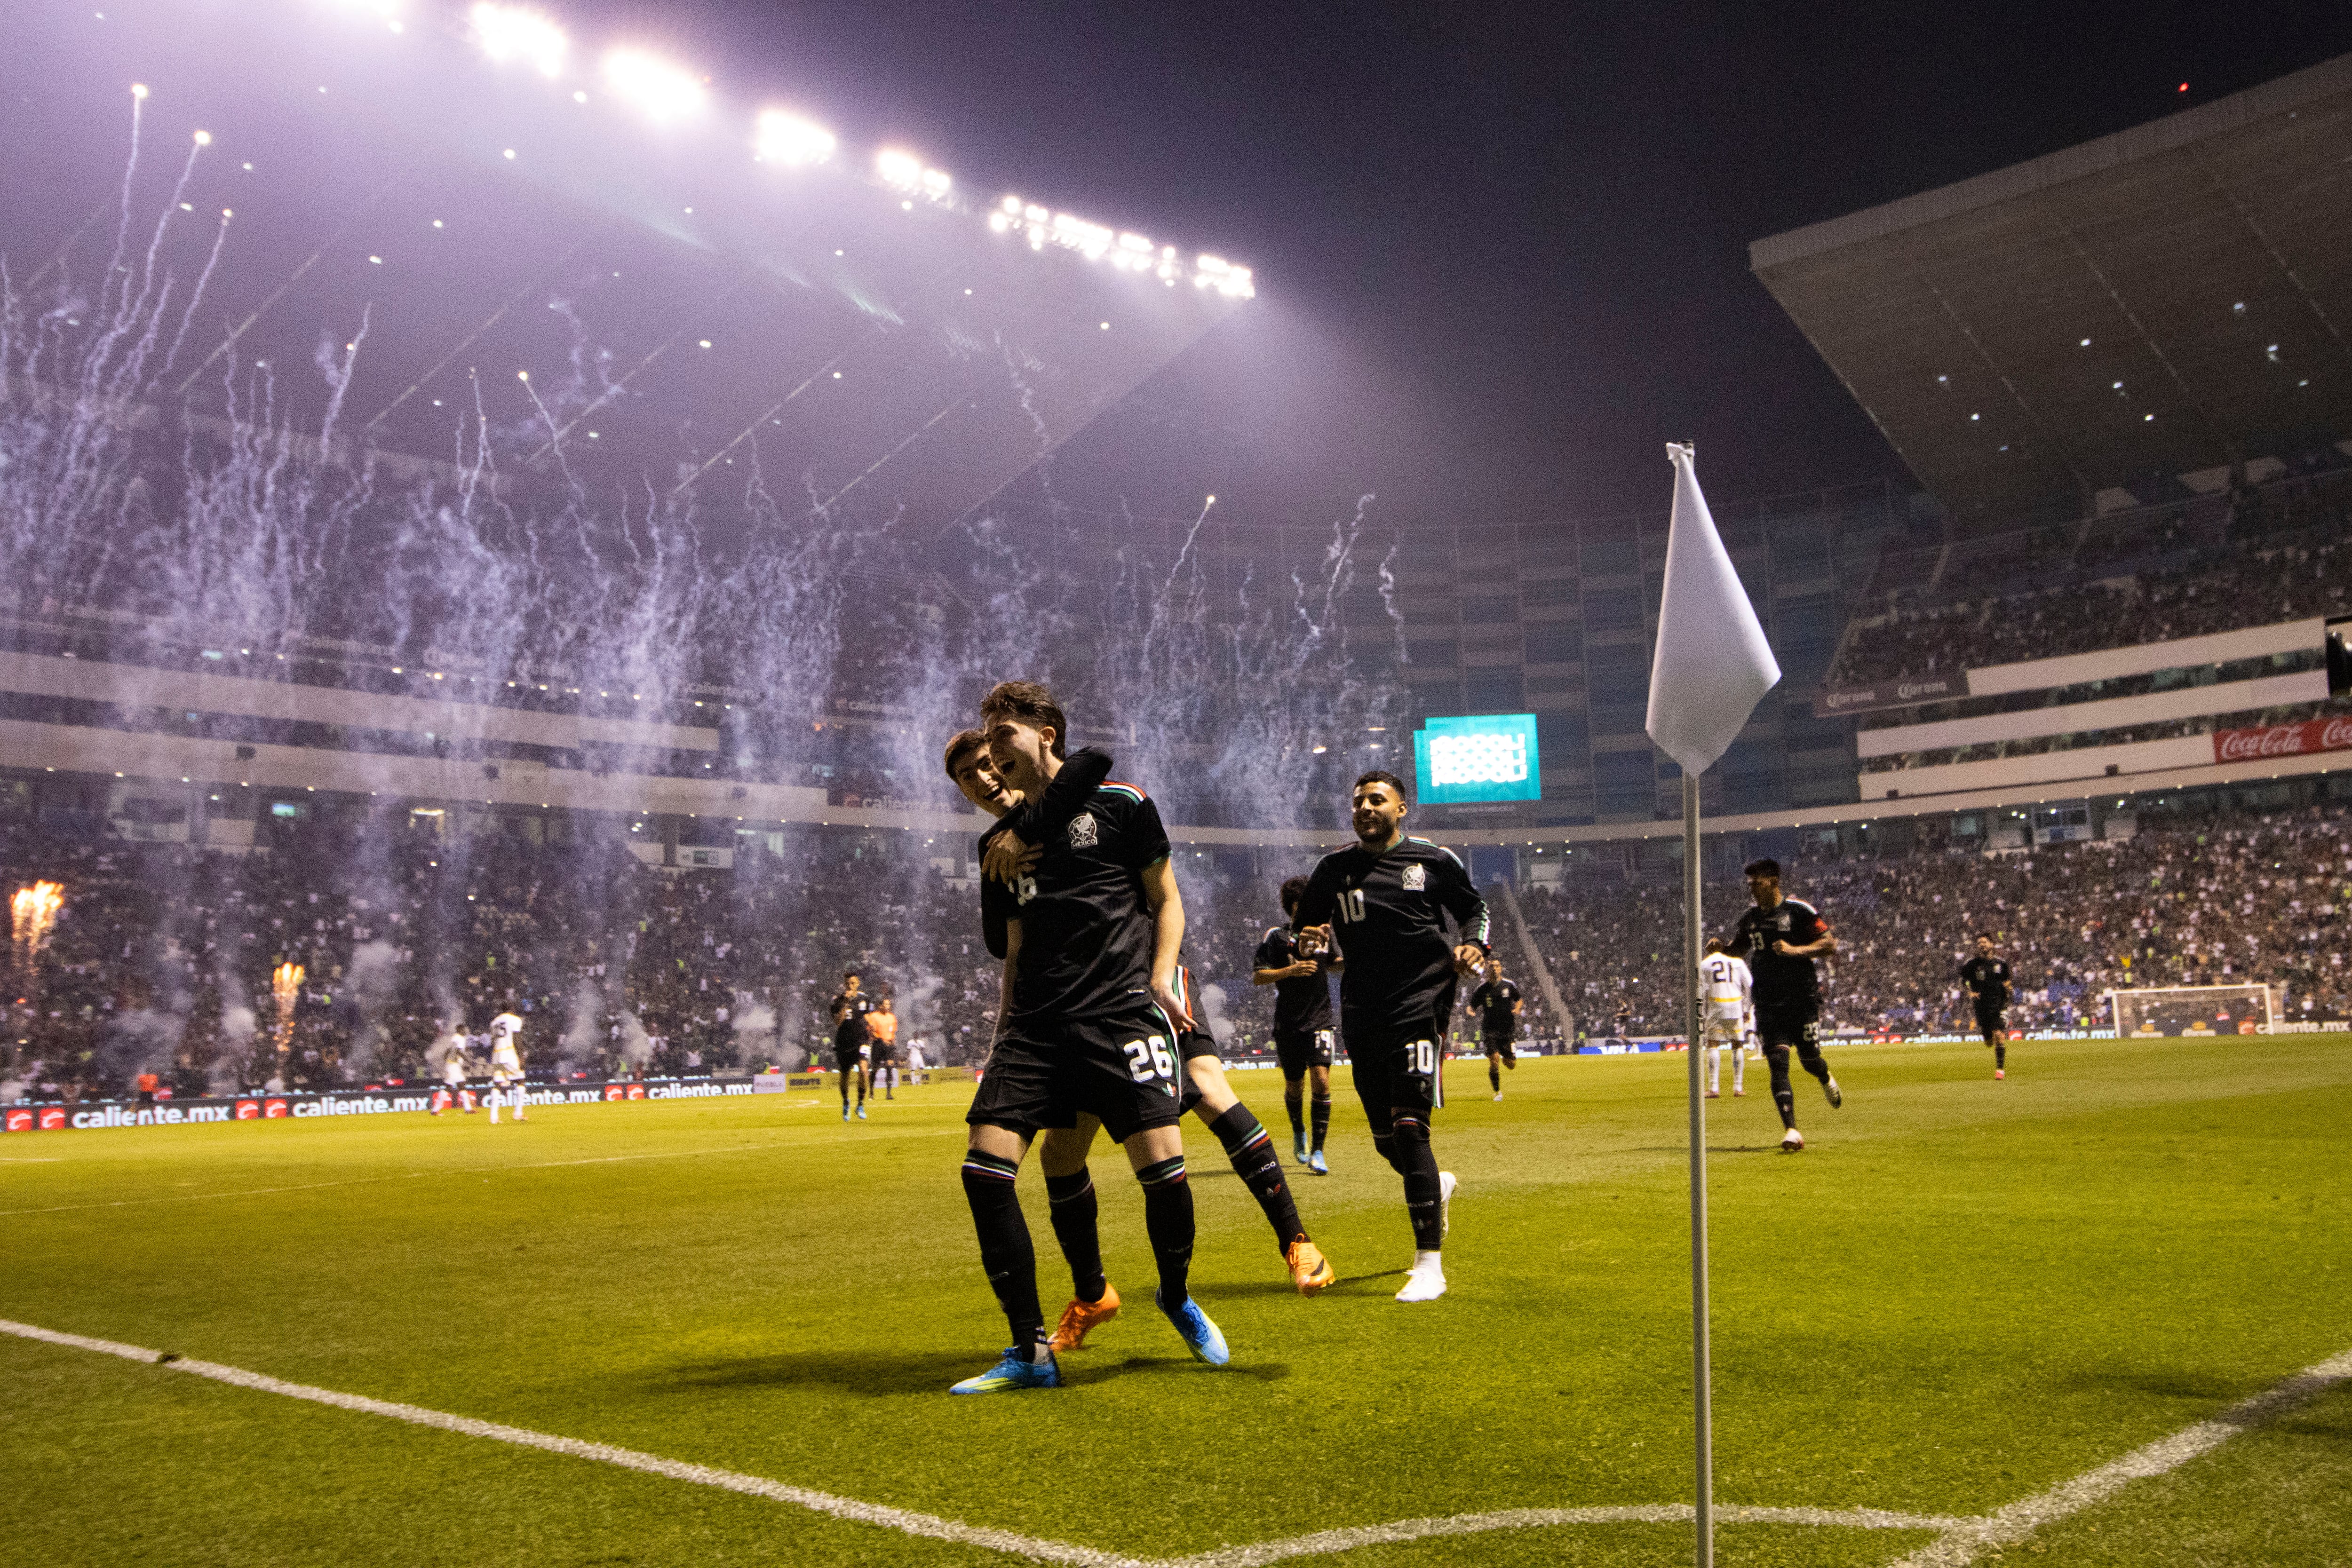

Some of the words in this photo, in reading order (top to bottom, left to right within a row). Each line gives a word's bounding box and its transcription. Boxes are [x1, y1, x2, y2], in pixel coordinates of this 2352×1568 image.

[1008, 873, 1037, 906] 6
[1337, 888, 1366, 924] 10
[1711, 961, 1732, 983] 21
[1123, 1035, 1173, 1083] 26
[1405, 1040, 1434, 1074] 10
[648, 1083, 753, 1100] caliente.mx
[72, 1105, 230, 1129] caliente.mx
[292, 1096, 429, 1117] caliente.mx
